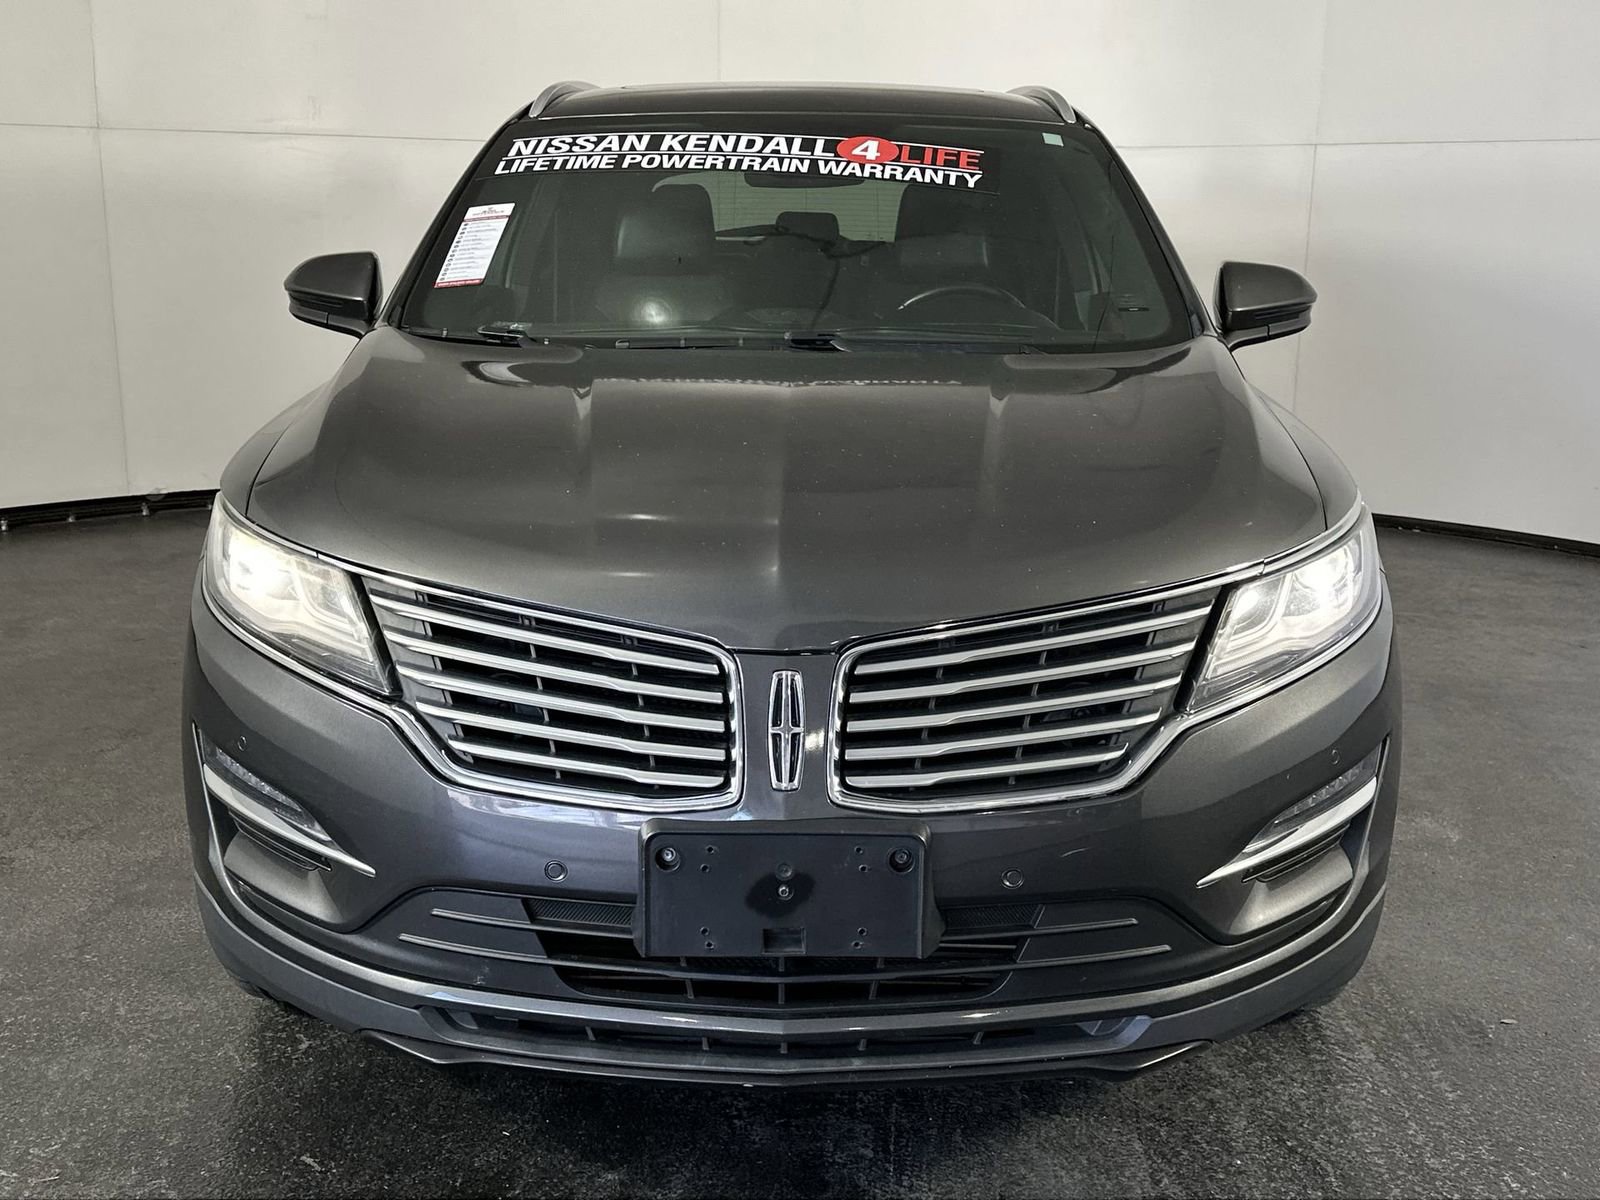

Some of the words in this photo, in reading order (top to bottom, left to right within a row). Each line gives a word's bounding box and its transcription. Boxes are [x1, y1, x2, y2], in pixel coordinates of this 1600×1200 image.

[507, 134, 651, 157] NISSAN
[659, 134, 835, 157] KENDALL
[851, 139, 881, 161] 4
[900, 145, 982, 170] LIFE
[494, 154, 615, 175] LIFETIME
[621, 154, 810, 174] POWERTRAIN
[817, 160, 983, 189] WARRANTY
